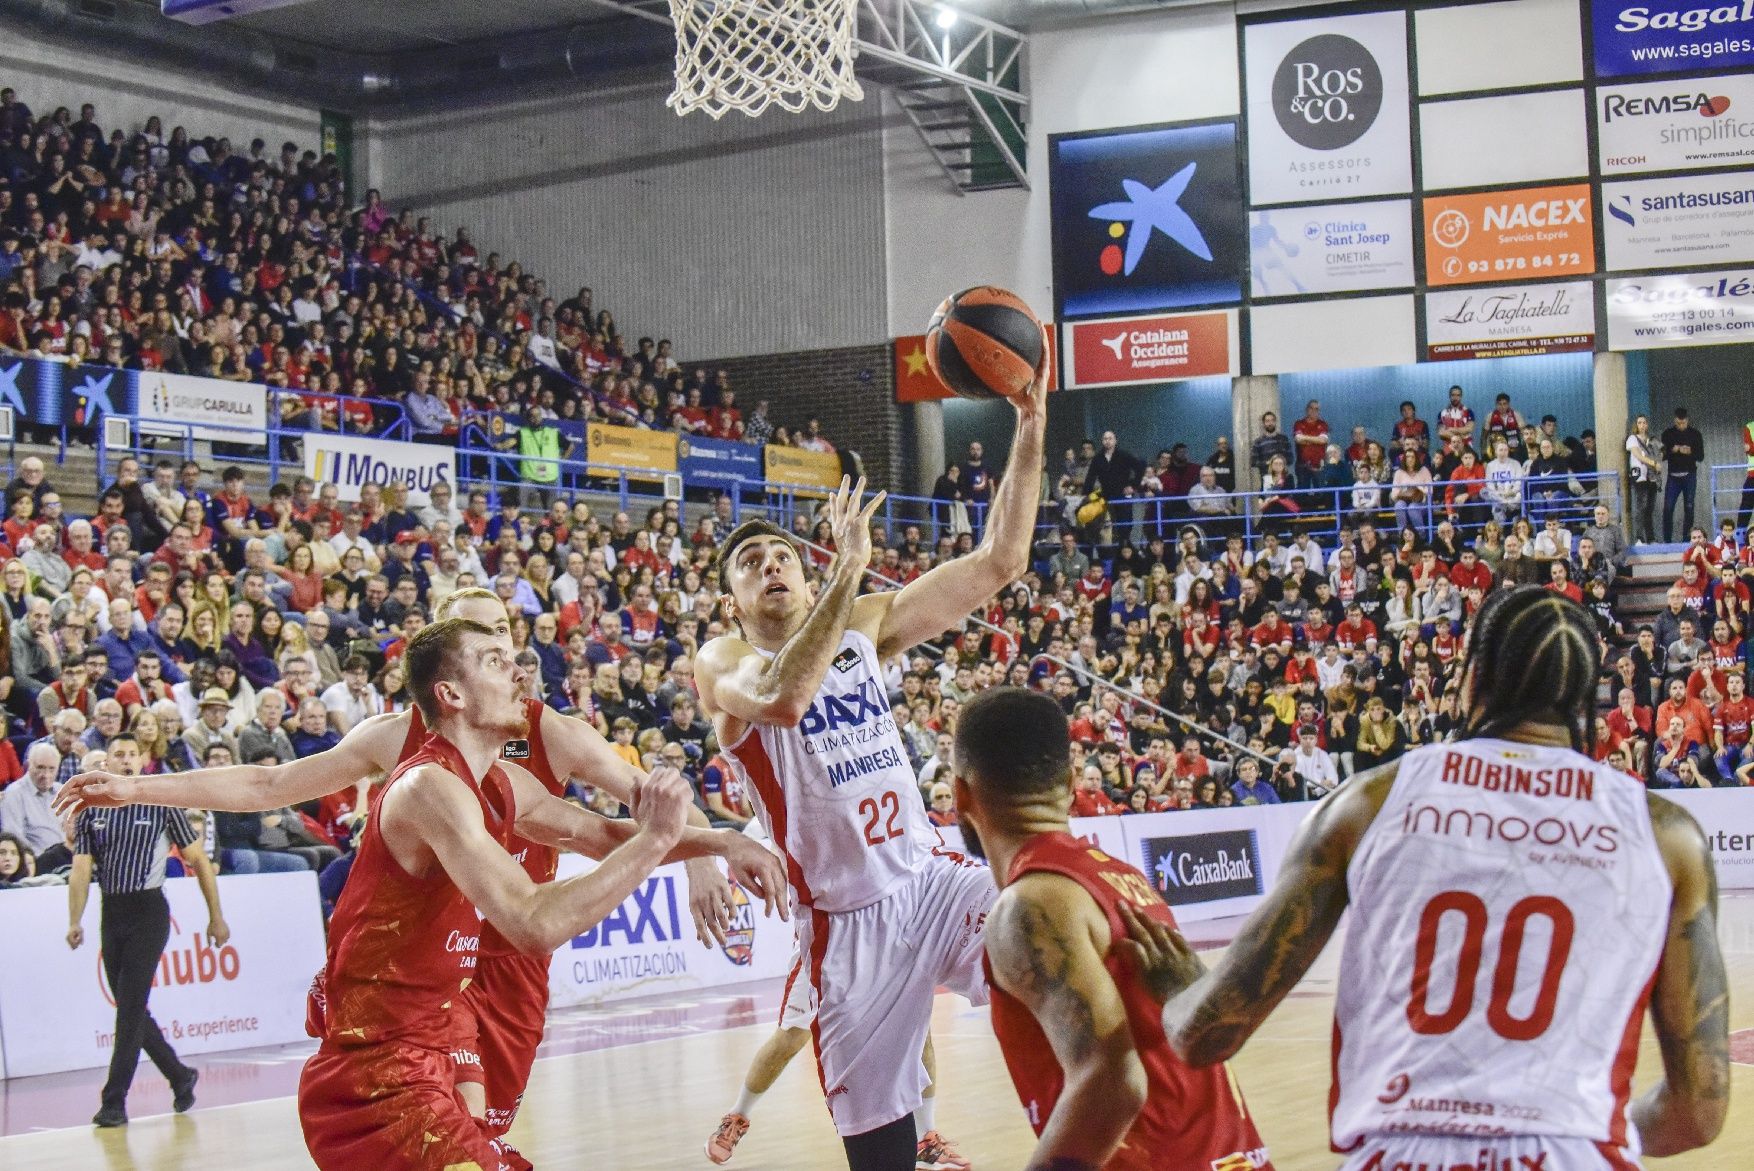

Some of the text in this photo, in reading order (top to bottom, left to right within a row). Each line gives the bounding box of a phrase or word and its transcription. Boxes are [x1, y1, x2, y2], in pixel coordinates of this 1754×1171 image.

[1288, 156, 1372, 173] Assessors
[1606, 155, 1646, 166] RICOH
[1483, 198, 1587, 231] NACEX
[1642, 215, 1661, 225] Grup
[1662, 215, 1673, 223] de
[1674, 211, 1710, 222] corredors
[1325, 221, 1367, 234] Clínica
[1671, 231, 1710, 241] Barcelona
[1325, 232, 1390, 247] Sant Josep
[1498, 232, 1534, 244] Servicio
[1654, 242, 1730, 254] www.santasusana.com
[1325, 251, 1371, 265] CIMETIR
[1467, 253, 1581, 273] 93 878 84 72
[1614, 277, 1754, 304] Sagalé
[1438, 289, 1570, 325] La Tagliatella
[1652, 307, 1735, 322] 902 13 00 14
[1129, 328, 1189, 345] Catalana
[1488, 325, 1533, 336] MANRESA
[1130, 342, 1189, 359] Occident
[827, 745, 903, 789] MANRESA
[1441, 751, 1594, 801] ROBINSON
[858, 790, 905, 847] 22
[1178, 848, 1253, 887] CaixaBank
[572, 945, 687, 985] CLIMATIZACIÓN
[1405, 890, 1575, 1042] 00
[187, 1015, 259, 1041] experience
[1406, 1098, 1495, 1117] Manresa
